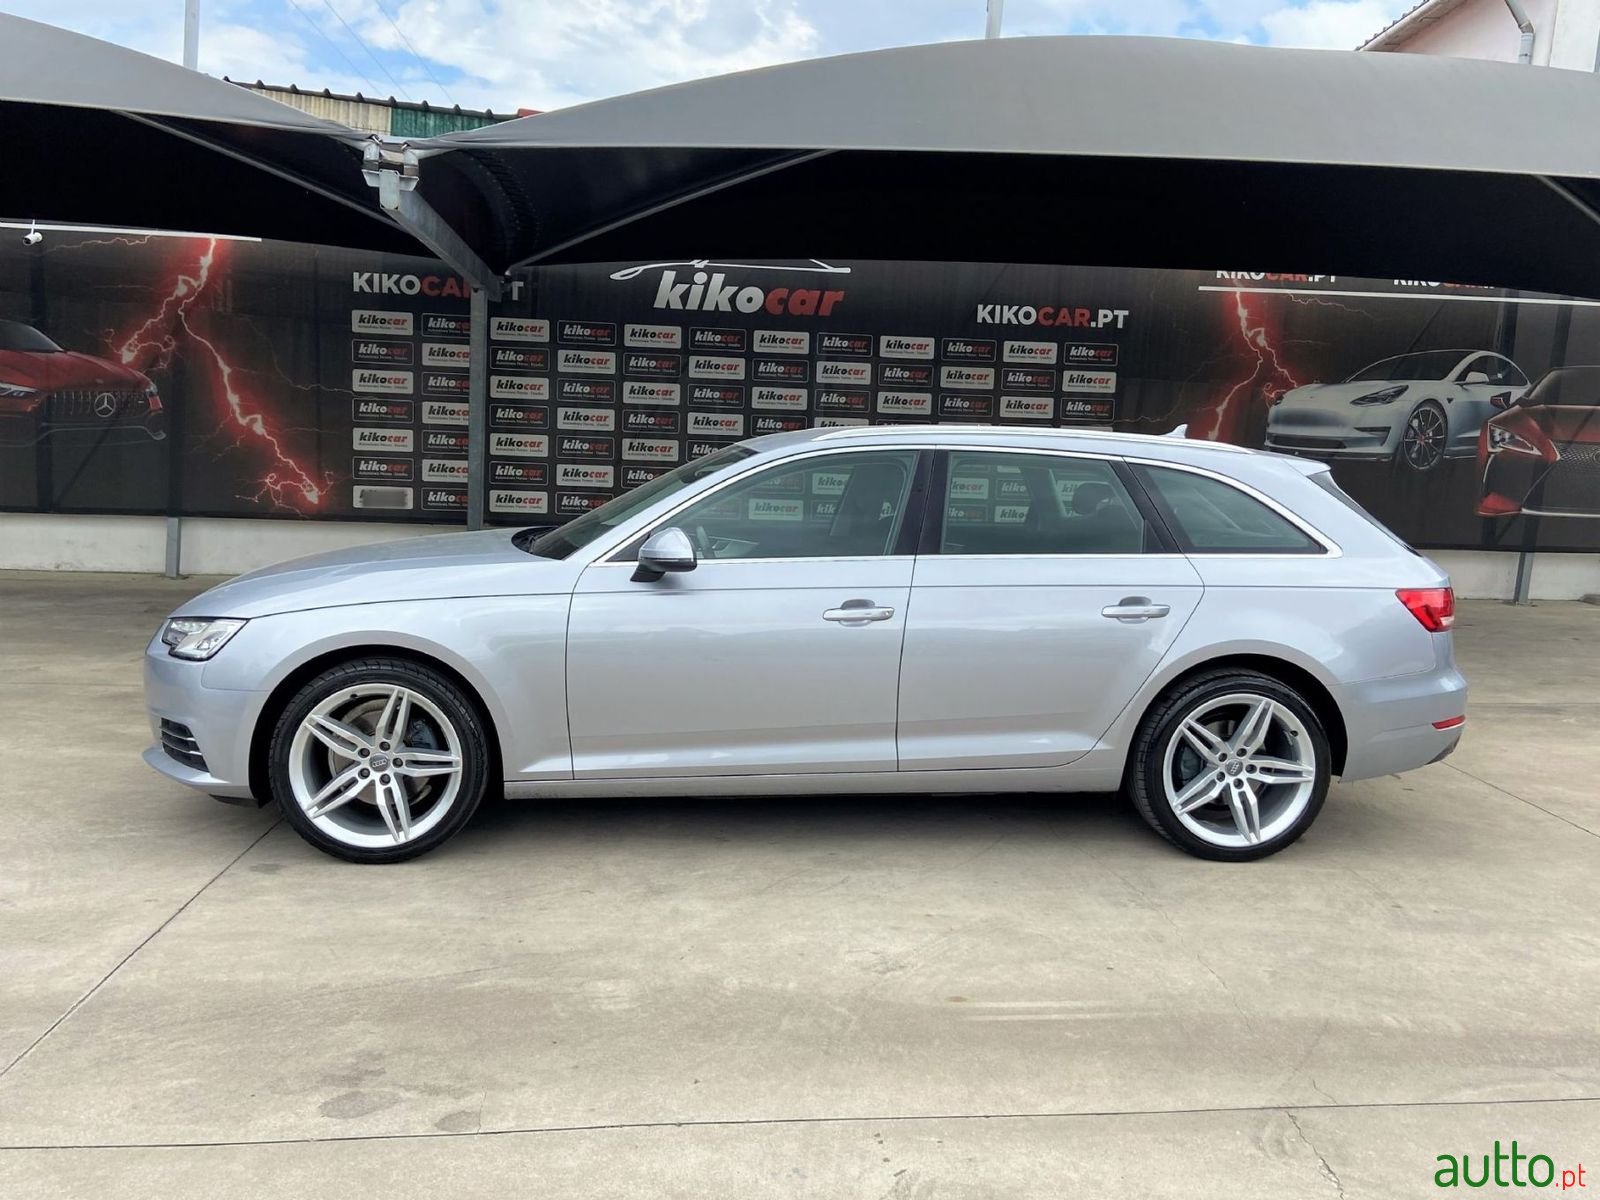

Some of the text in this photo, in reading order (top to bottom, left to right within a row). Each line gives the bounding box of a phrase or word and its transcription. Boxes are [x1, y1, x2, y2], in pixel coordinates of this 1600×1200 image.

[353, 272, 524, 300] KIKOCAT
[653, 270, 844, 316] kikocar
[359, 314, 408, 326] kikocar
[976, 304, 1129, 328] KIKOCAR.PT
[428, 318, 470, 330] kikoca
[496, 322, 544, 332] kikocar
[564, 325, 610, 336] kikocar
[630, 328, 676, 339] kikocar
[695, 331, 740, 342] kikocar
[760, 334, 804, 345] kikocar
[823, 337, 866, 348] kikocar
[886, 340, 929, 350] kikocar
[948, 342, 991, 352] kikocar
[359, 344, 408, 356] kikocar
[428, 348, 470, 359] kikoca
[1009, 345, 1052, 355] kikocar
[1070, 347, 1112, 357] kikocar
[496, 350, 544, 362] kikocar
[564, 354, 610, 365] kikocar
[630, 357, 675, 368] kikocar
[695, 360, 739, 370] kikocar
[758, 362, 803, 373] kikocar
[822, 365, 866, 376] kikocar
[884, 368, 928, 378] kikocar
[946, 370, 989, 380] kikocar
[360, 374, 408, 384] kikocar
[428, 376, 470, 388] kikoca
[1008, 373, 1050, 383] kikocar
[1069, 375, 1111, 384] kikocar
[496, 380, 544, 391] kikocar
[563, 383, 609, 394] kikocar
[629, 386, 675, 396] kikocar
[694, 388, 738, 399] kikocar
[758, 391, 802, 401] kikocar
[821, 393, 864, 404] kikocar
[883, 396, 926, 406] kikocar
[945, 398, 987, 408] kikocar
[359, 403, 408, 414] kikocar
[1006, 400, 1048, 410] kikocar
[1066, 402, 1109, 411] kikocar
[428, 406, 469, 416] kikoca
[496, 409, 543, 419] kikocar
[564, 412, 609, 422] kikocar
[629, 414, 674, 424] kikocar
[693, 417, 738, 427] kikocar
[360, 432, 408, 443] kikocar
[428, 434, 469, 446] kikoca
[496, 437, 543, 448] kikocar
[563, 440, 608, 450] kikocar
[628, 442, 673, 452] kikocar
[692, 445, 720, 454] kiko
[360, 461, 408, 472] kikocar
[428, 464, 468, 474] kikoca
[496, 466, 543, 477] kikocar
[562, 468, 608, 478] kikocar
[627, 470, 658, 480] kiko
[428, 492, 468, 503] kikoca
[496, 494, 542, 504] kikocar
[1000, 508, 1025, 518] kiko
